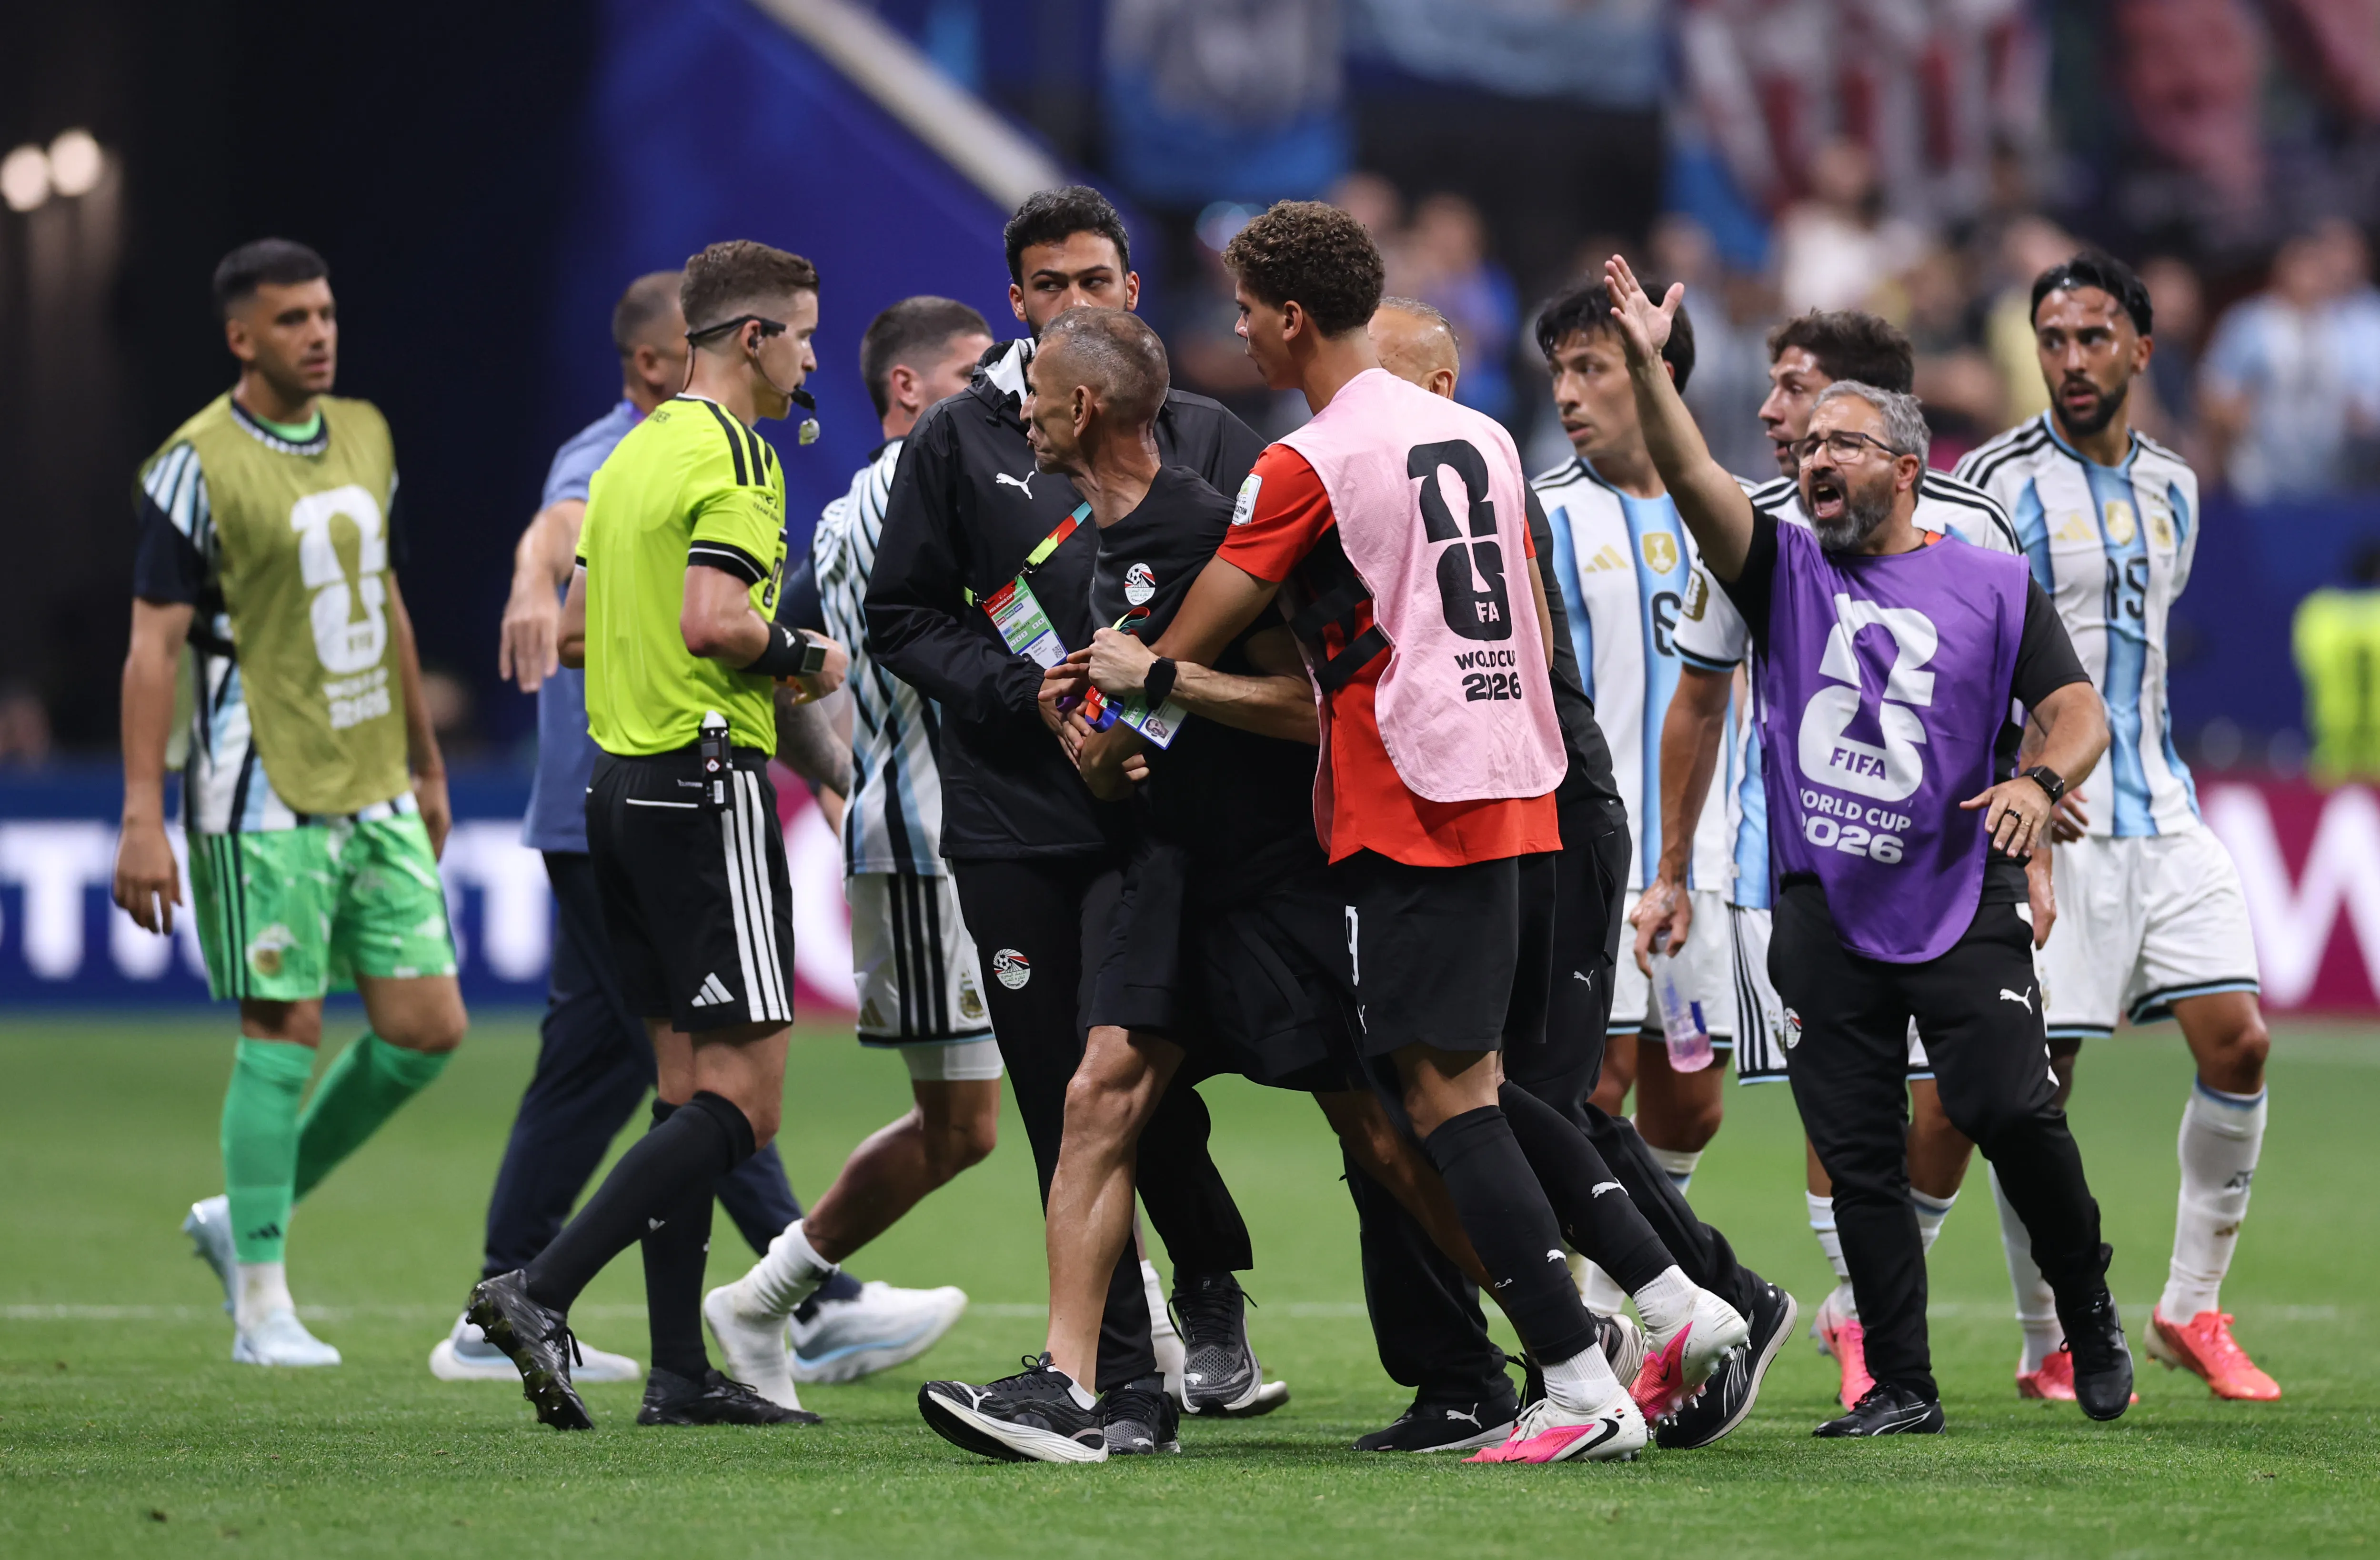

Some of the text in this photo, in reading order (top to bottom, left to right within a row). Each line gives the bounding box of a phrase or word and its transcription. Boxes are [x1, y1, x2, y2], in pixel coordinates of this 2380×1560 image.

[996, 598, 1007, 608] WORLD
[1454, 650, 1516, 670] WOLD CU
[1829, 746, 1886, 780] FIFA
[1800, 787, 1912, 832] ORLD CUP
[1801, 811, 1904, 865] 026
